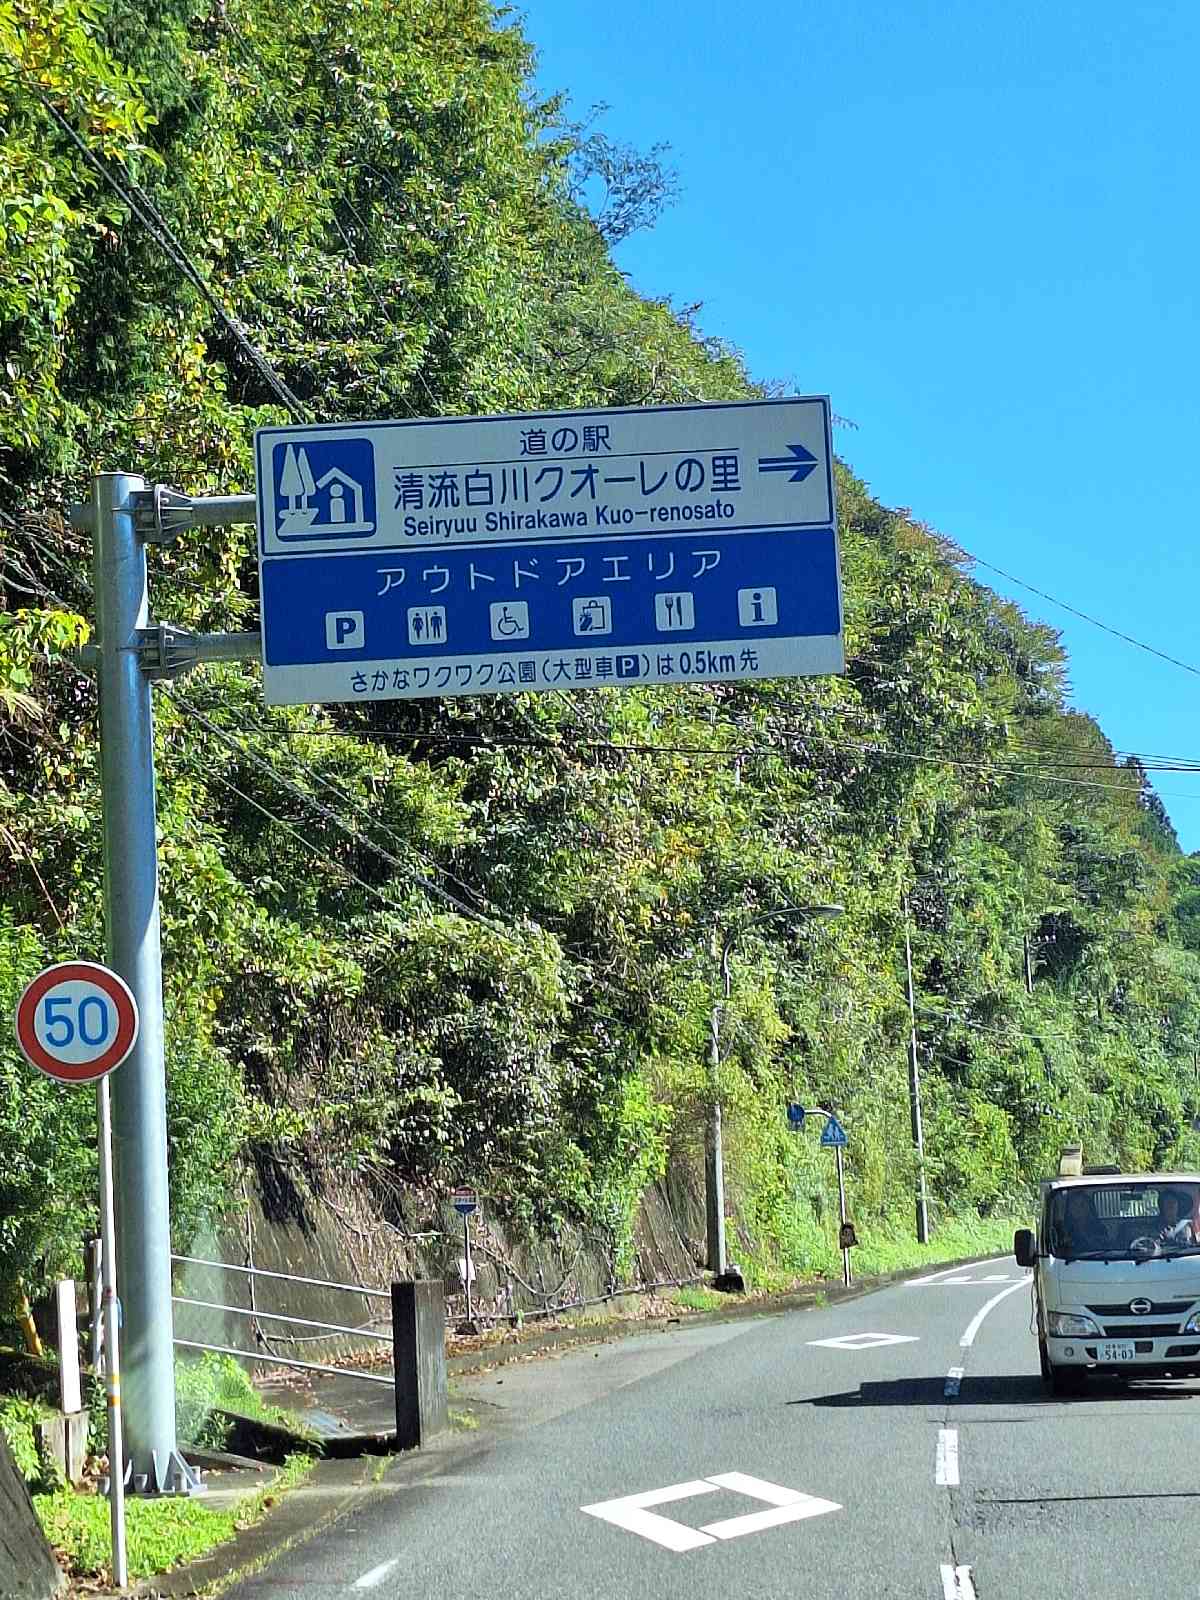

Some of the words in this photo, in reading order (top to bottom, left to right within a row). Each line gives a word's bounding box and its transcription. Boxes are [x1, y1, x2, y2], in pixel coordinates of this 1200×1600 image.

[520, 425, 612, 456] 道の駅
[394, 456, 742, 511] 清流白川クオーレの里
[403, 515, 477, 538] Seiryuu
[485, 508, 588, 533] Shirakawa
[595, 499, 735, 526] Kuo-renosato
[376, 550, 721, 596] アウトドアエリア
[335, 617, 357, 644] P
[44, 996, 109, 1048] 50
